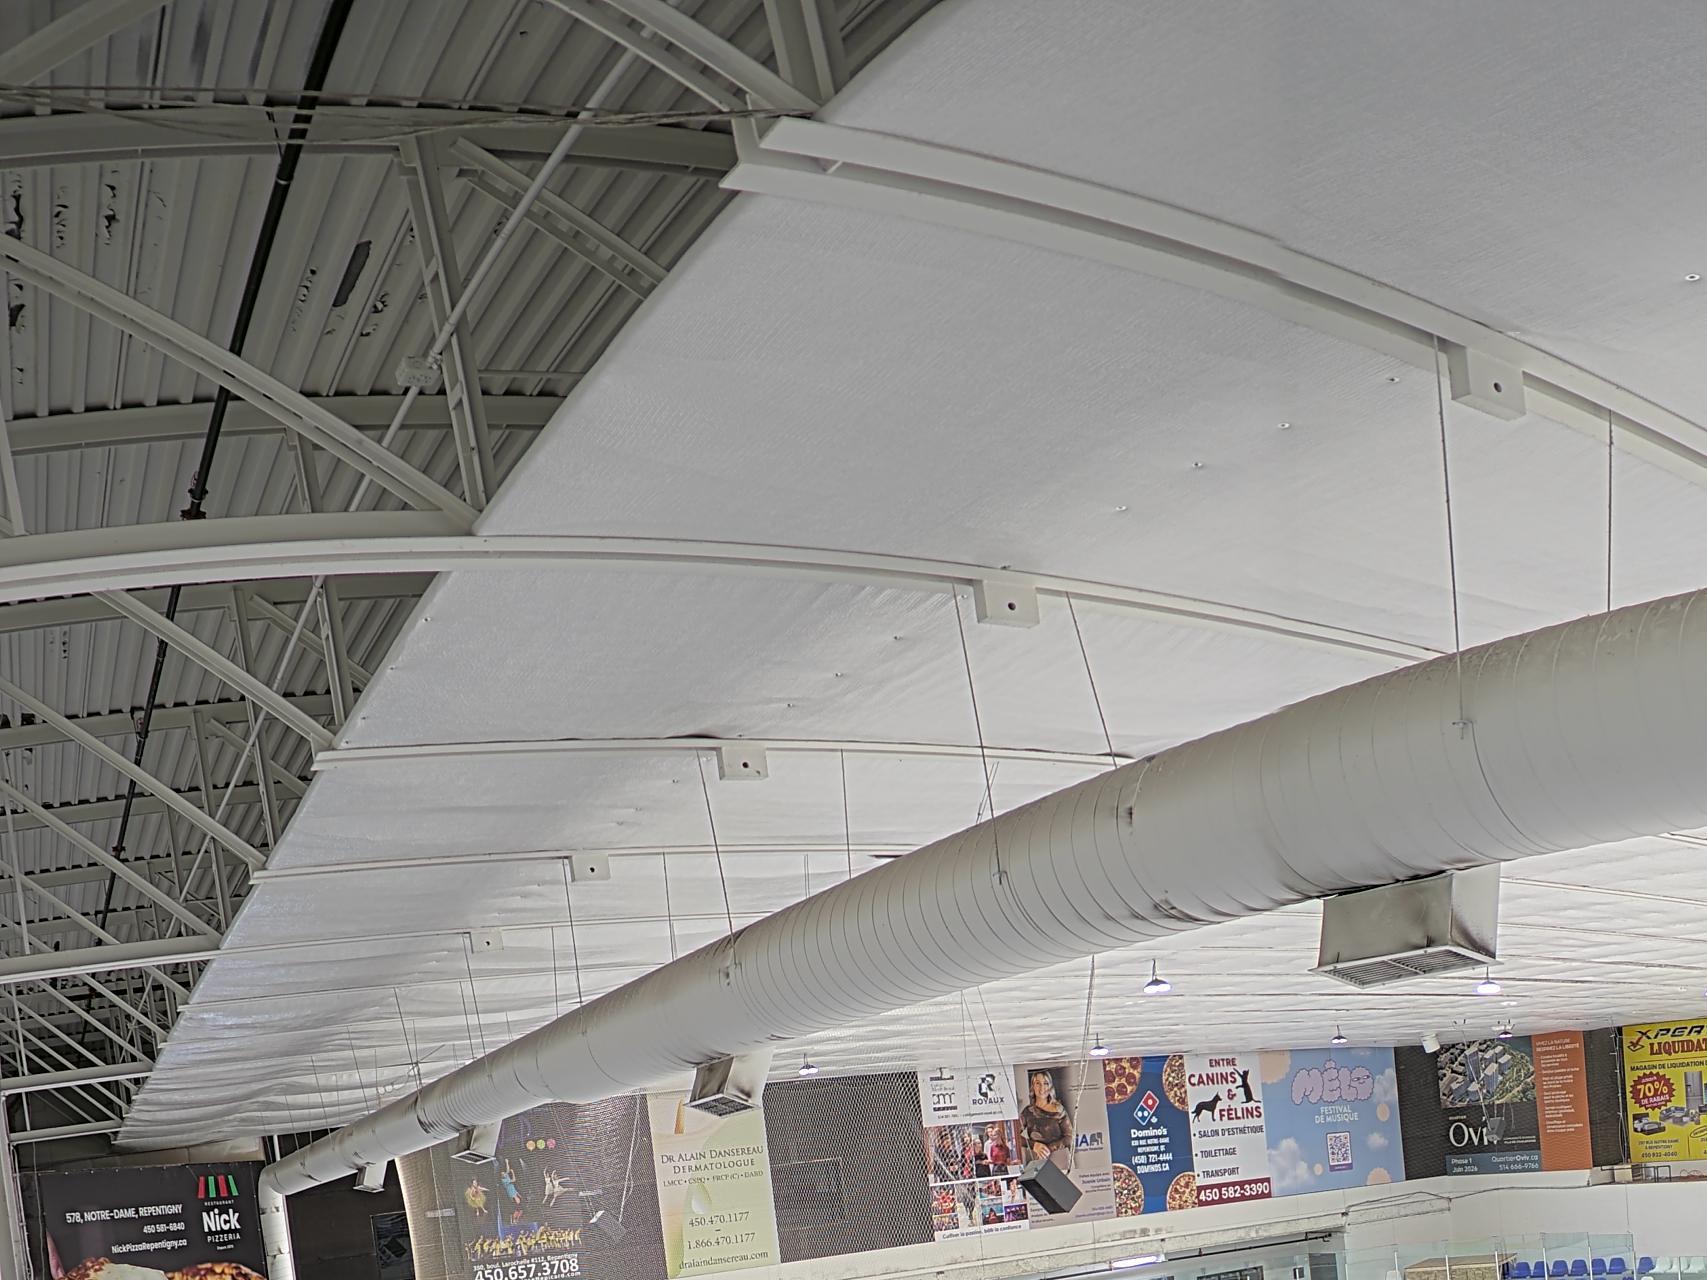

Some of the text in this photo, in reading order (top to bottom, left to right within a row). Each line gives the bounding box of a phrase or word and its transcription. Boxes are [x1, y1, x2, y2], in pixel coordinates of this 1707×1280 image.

[1209, 1058, 1237, 1067] ENTRE
[1667, 1061, 1704, 1069] LIQUIDATION
[1188, 1072, 1237, 1087] CANINS
[1227, 1089, 1236, 1100] &
[1636, 1080, 1668, 1098] 70%
[972, 1096, 1005, 1106] ROYAUX
[1649, 1095, 1670, 1103] RABAIS
[1219, 1105, 1262, 1121] FÉLINS
[1320, 1105, 1352, 1114] FESTIVAL
[1315, 1113, 1359, 1123] DE MUSIQUE
[1131, 1126, 1167, 1138] Domino's
[1198, 1124, 1264, 1138] SALON D'ESTHÉTIQUE
[678, 1146, 763, 1162] ALAIN DANSEREAU
[1200, 1147, 1237, 1158] TOILETTAGE
[673, 1158, 755, 1174] DERMATOLOGUE
[1137, 1163, 1169, 1174] DOMINOS.CA
[1202, 1167, 1239, 1179] TRANSPORT
[1199, 1182, 1269, 1201] 450 582-3390
[66, 1204, 183, 1224] 578, NOTRE-DAME, REPENTIGNY
[202, 1209, 241, 1232] Nick
[688, 1211, 750, 1227] 450.470.1177
[143, 1224, 155, 1233] 450
[207, 1233, 241, 1243] PIZZERIA
[687, 1232, 755, 1250] 1.866.470.1177
[112, 1239, 187, 1253] NickPizzaRepentigny.ca
[679, 1251, 768, 1270] dralaindansereau.com
